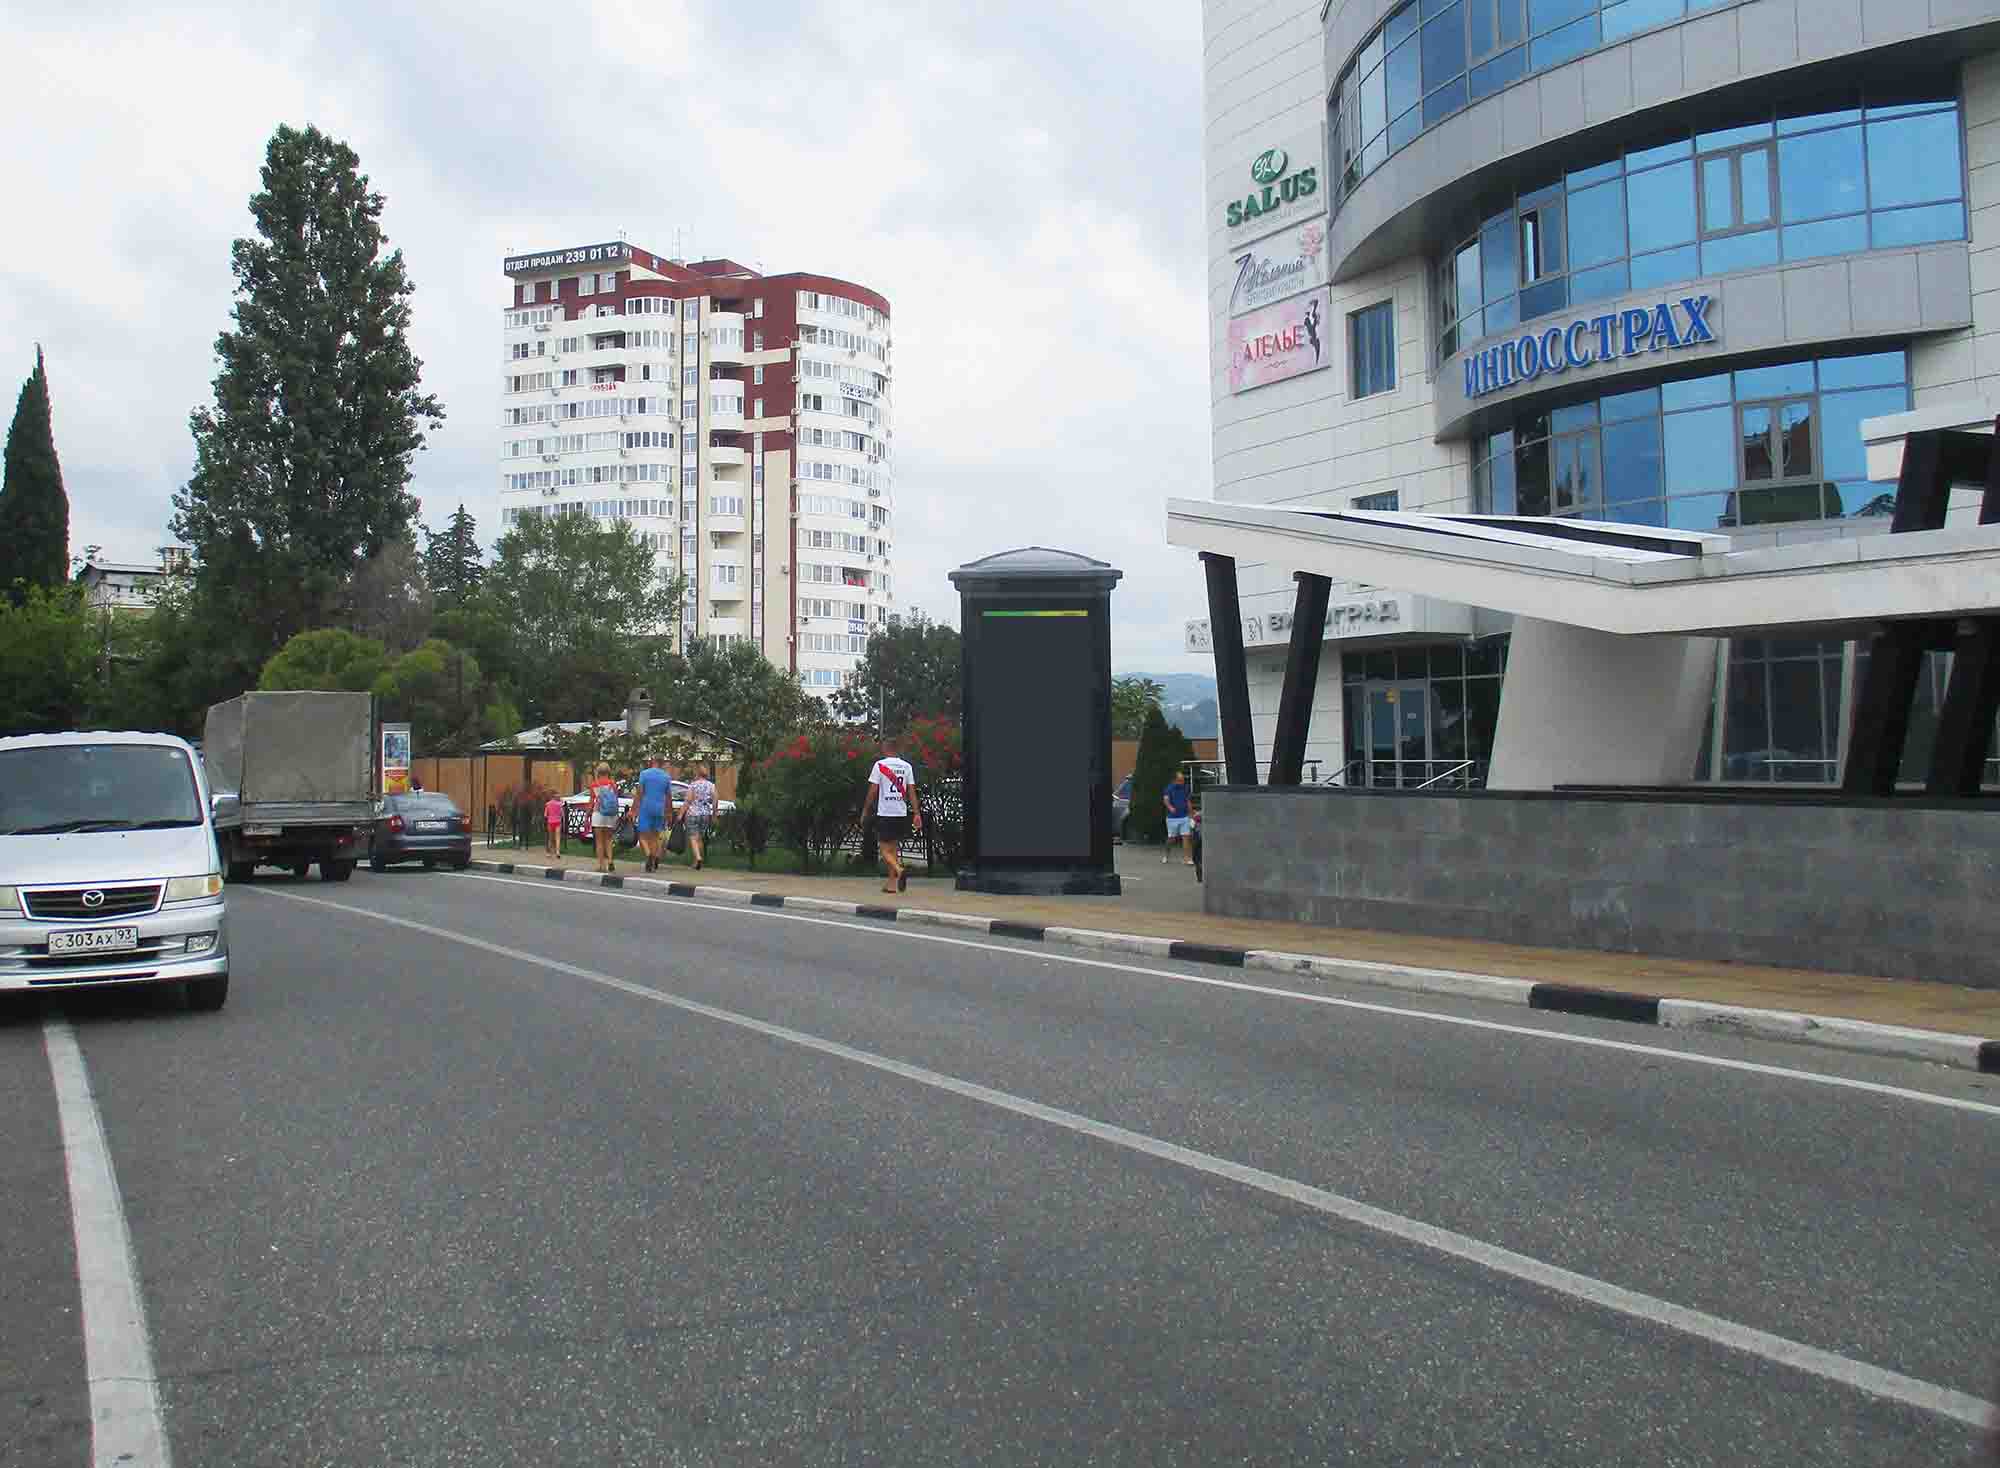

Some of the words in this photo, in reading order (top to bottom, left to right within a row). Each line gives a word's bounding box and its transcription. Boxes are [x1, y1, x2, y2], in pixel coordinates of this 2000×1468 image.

[1226, 167, 1318, 228] SALUS
[505, 260, 529, 271] ОТДЕЛ
[531, 255, 564, 267] ПРОДАЖ
[565, 249, 586, 263] 239
[590, 247, 602, 260] 01
[606, 245, 619, 258] 12
[1245, 325, 1305, 362] АТЕЛЬЕ
[1464, 295, 1714, 398] ИНГОССТРАХ
[118, 929, 132, 940] 93
